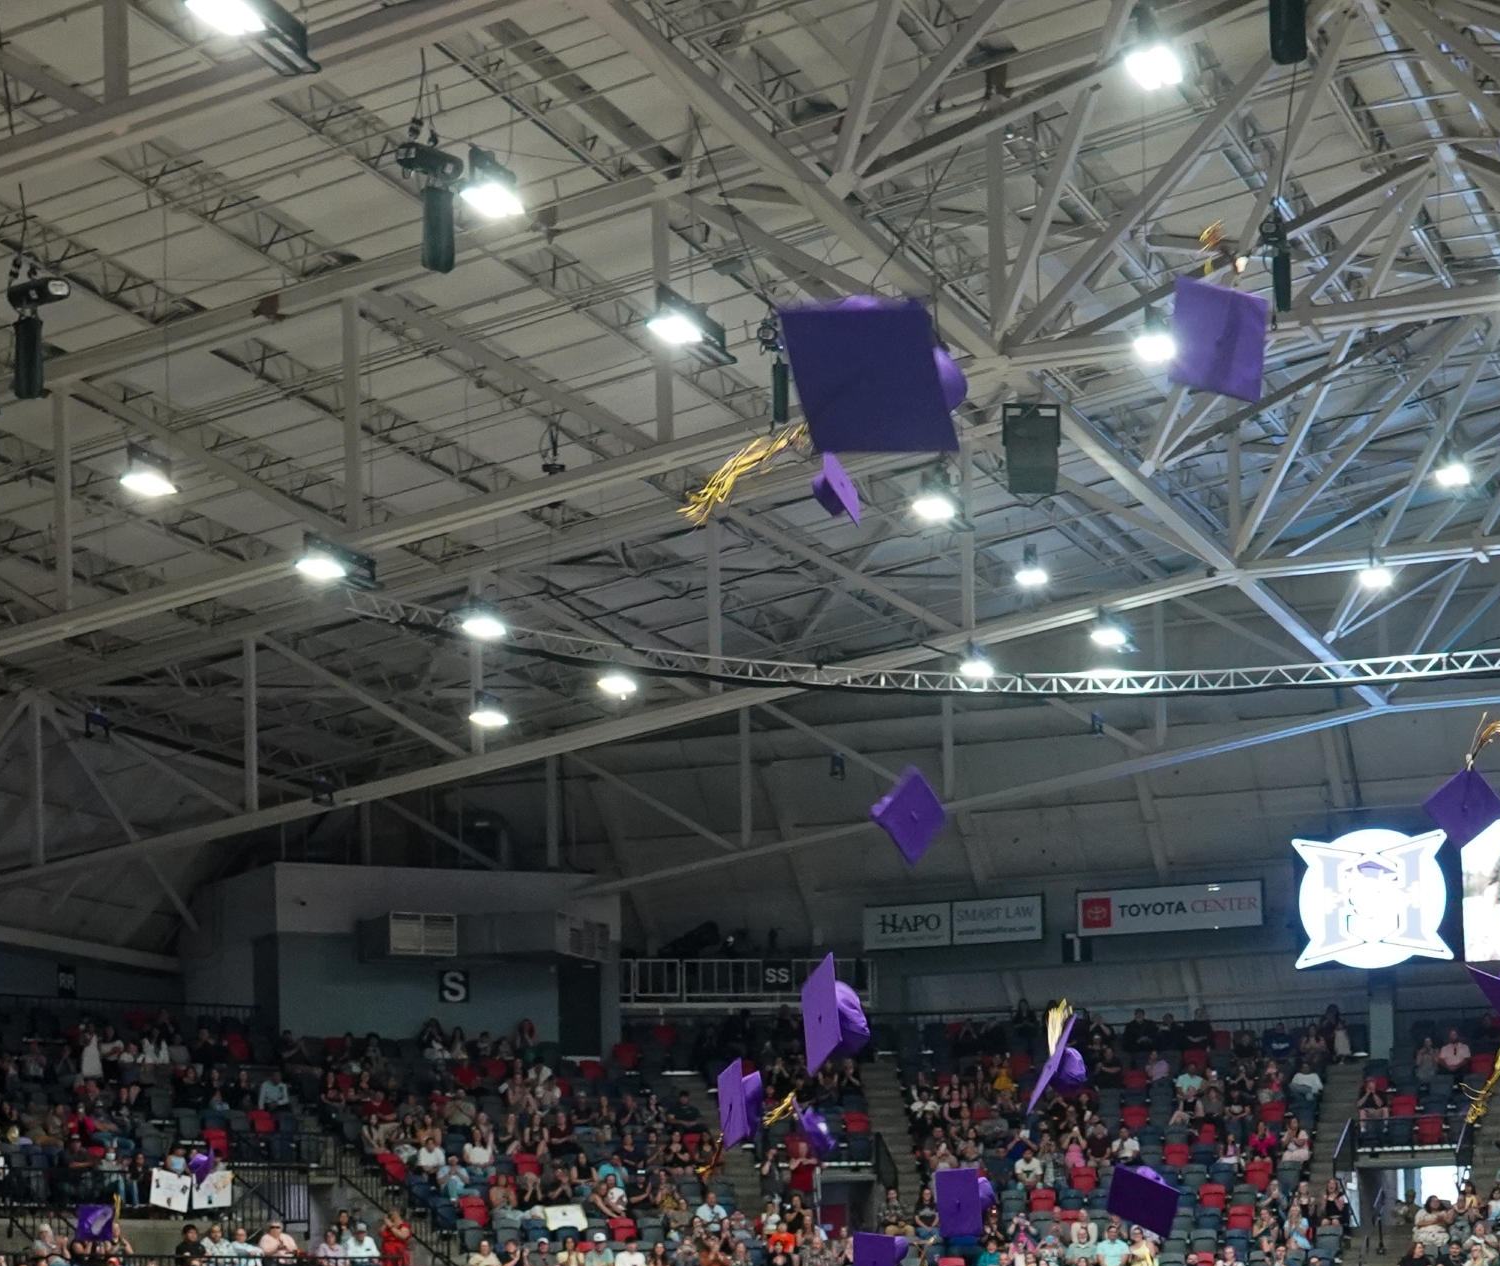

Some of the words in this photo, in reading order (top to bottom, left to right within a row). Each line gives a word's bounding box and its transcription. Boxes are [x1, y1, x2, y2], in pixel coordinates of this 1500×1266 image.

[1005, 904, 1036, 920] LAW
[1118, 900, 1188, 918] TOYOTA
[1191, 896, 1258, 915] CENTER
[876, 913, 941, 935] HAPO
[765, 967, 789, 983] SS
[443, 971, 467, 1002] S
